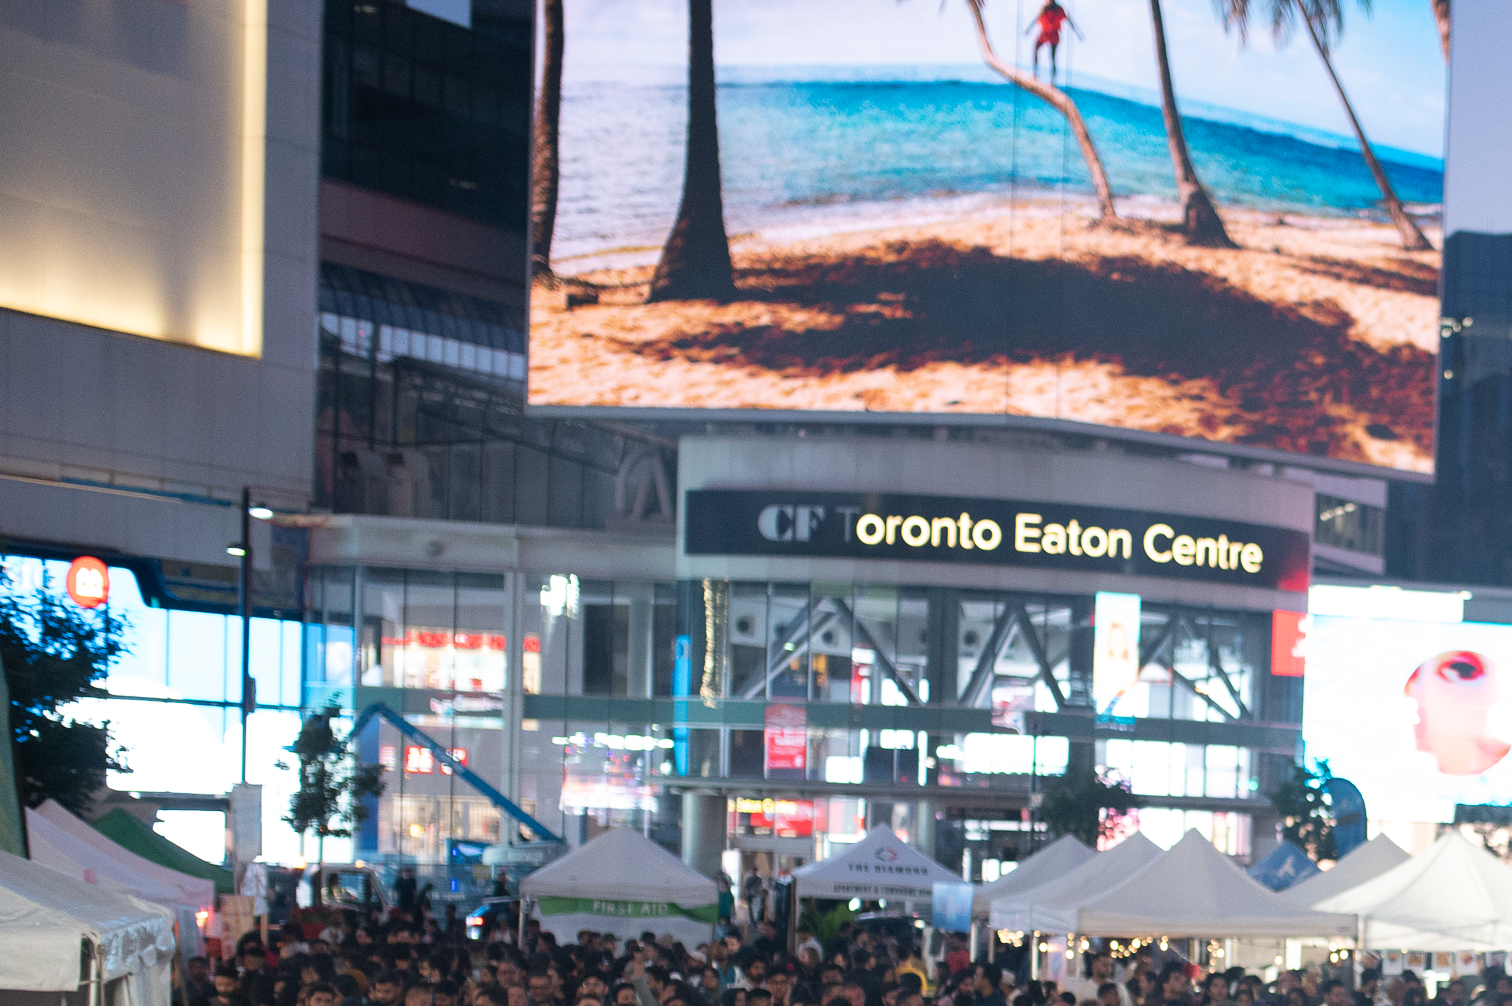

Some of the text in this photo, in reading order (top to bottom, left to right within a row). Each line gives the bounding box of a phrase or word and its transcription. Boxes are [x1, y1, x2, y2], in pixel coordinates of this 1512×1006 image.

[758, 505, 1265, 574] CF Toronto Eaton Centre
[594, 901, 669, 916] FIRST AID
